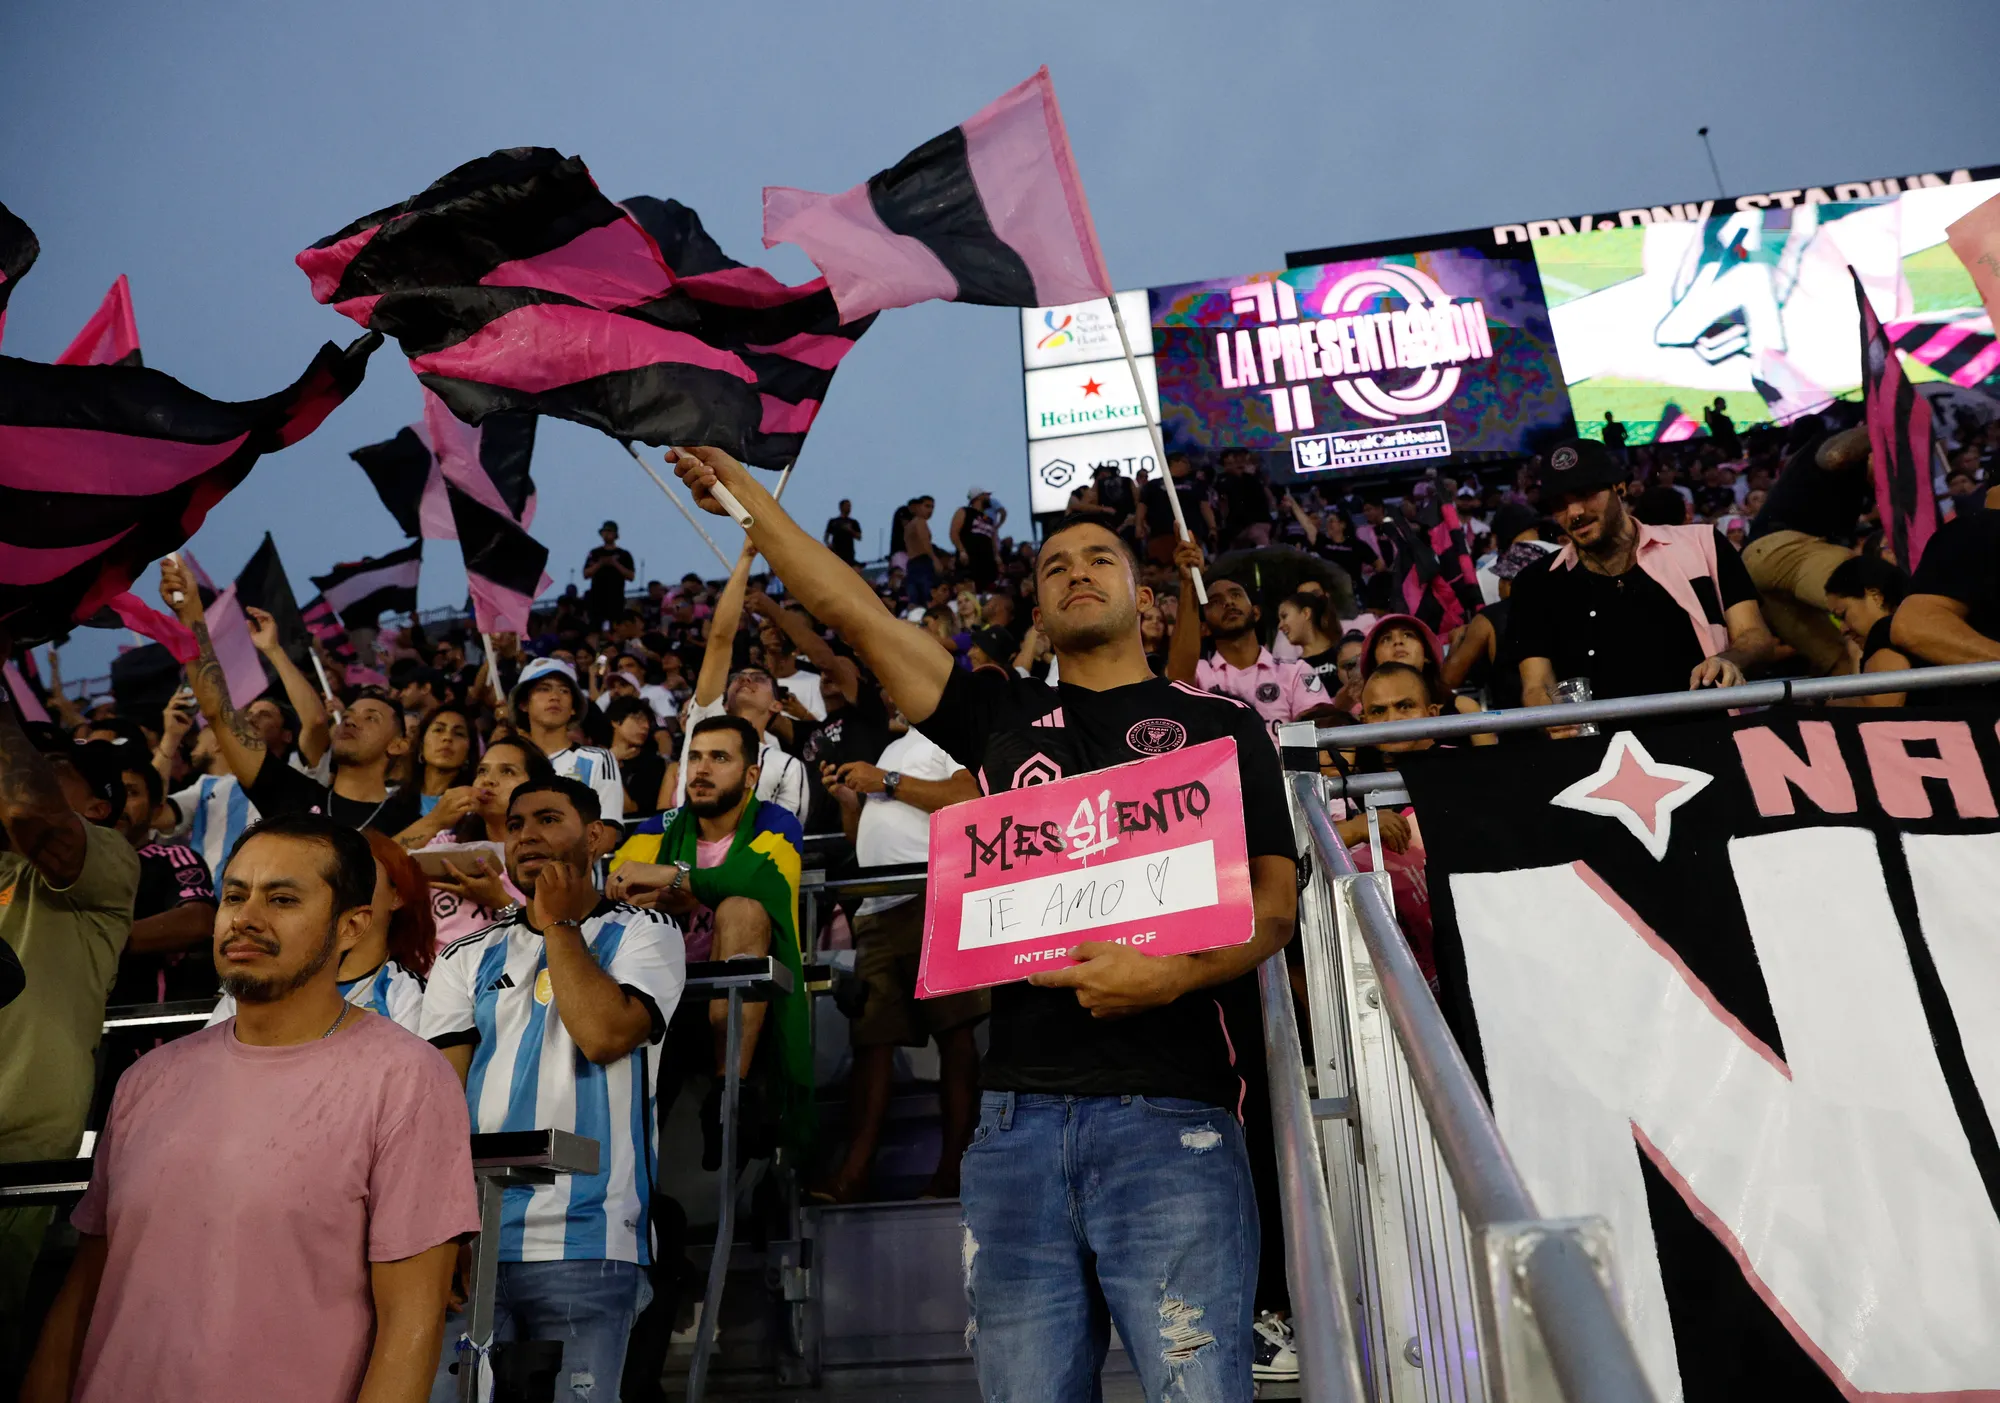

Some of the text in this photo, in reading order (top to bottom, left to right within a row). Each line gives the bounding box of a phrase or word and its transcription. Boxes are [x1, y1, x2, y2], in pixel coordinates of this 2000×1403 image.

[1076, 319, 1128, 333] Nationl
[1216, 329, 1260, 389] LA
[1733, 720, 2000, 819] NA
[975, 879, 1125, 938] TE AMO
[1013, 947, 1067, 965] INTER
[1131, 931, 1157, 945] CF
